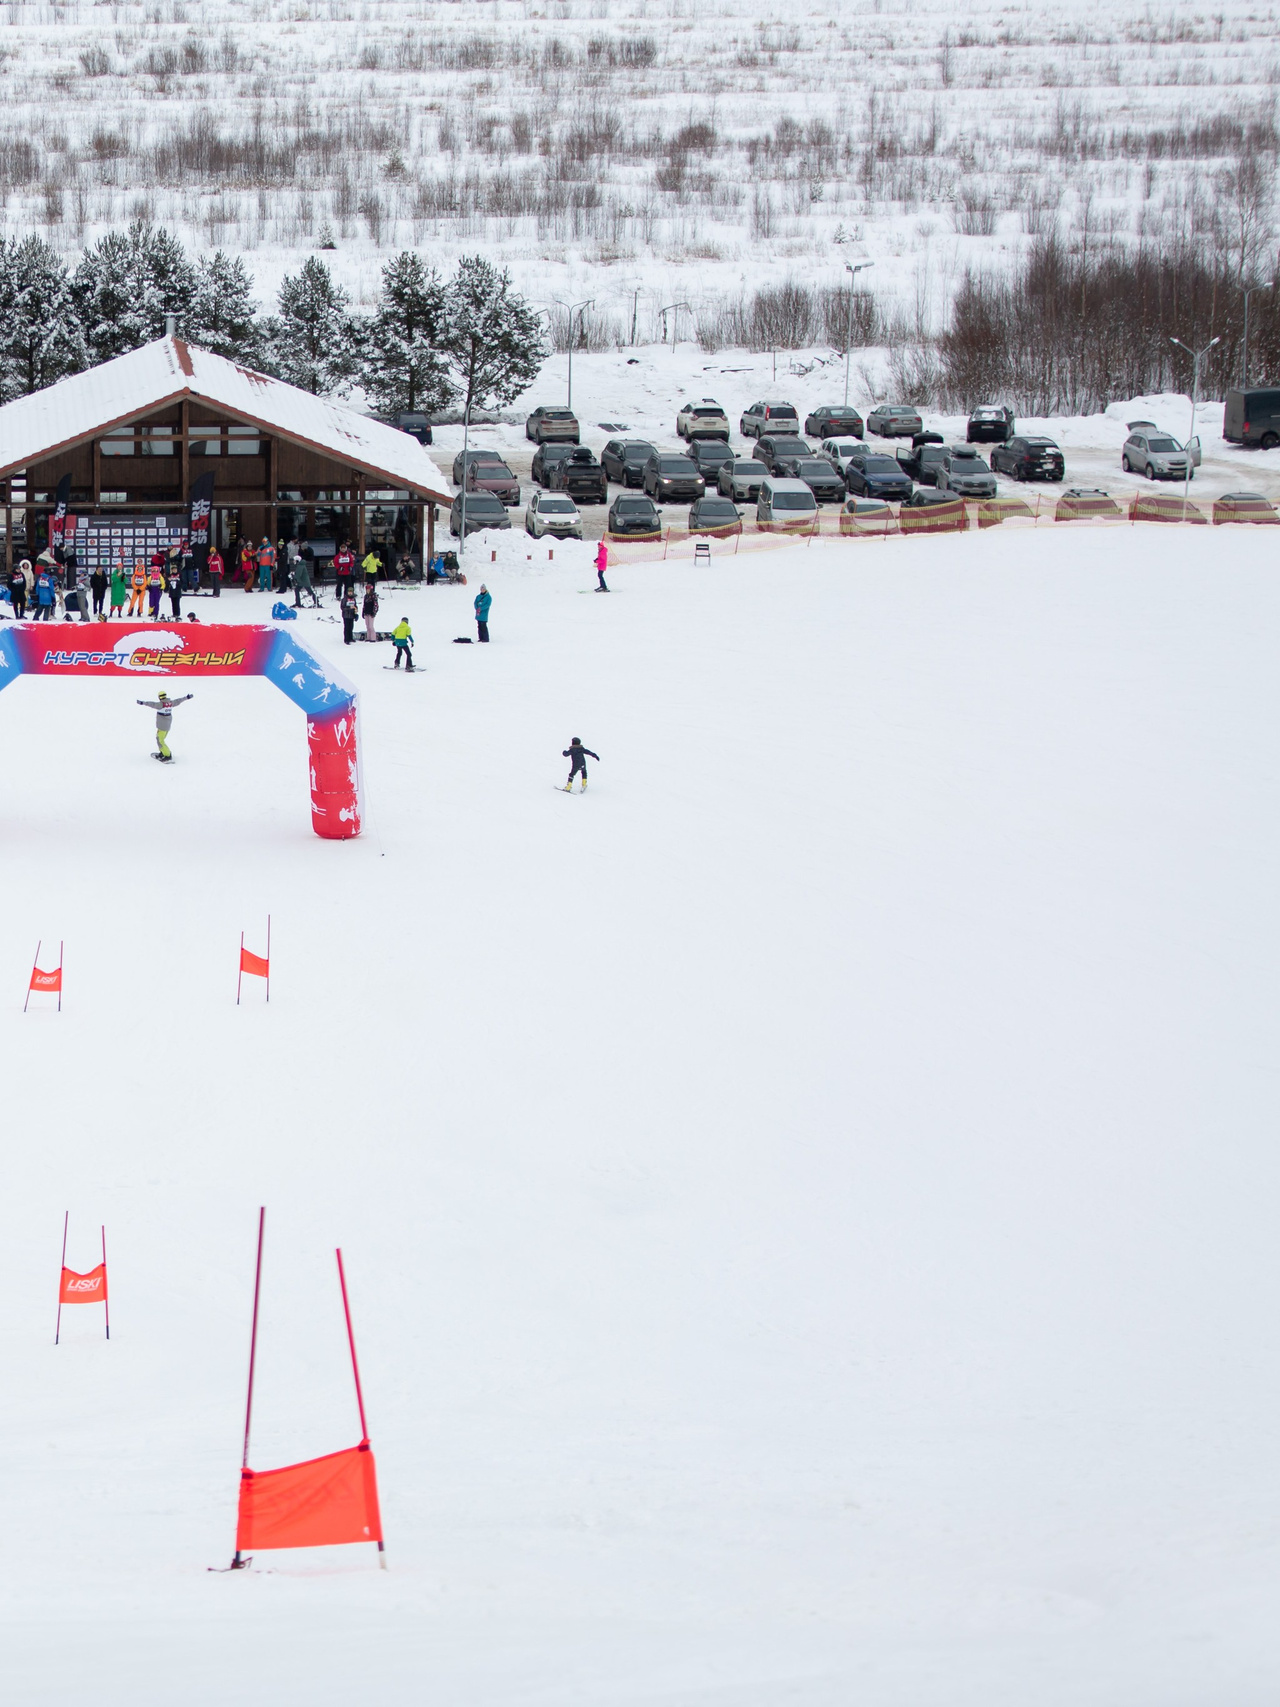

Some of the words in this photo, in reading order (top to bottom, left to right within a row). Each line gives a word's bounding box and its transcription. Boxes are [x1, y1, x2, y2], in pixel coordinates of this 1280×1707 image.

[43, 651, 129, 666] КУРОРТ
[130, 649, 246, 666] СНЕЖНЫЙ
[67, 1277, 103, 1290] LISKI
